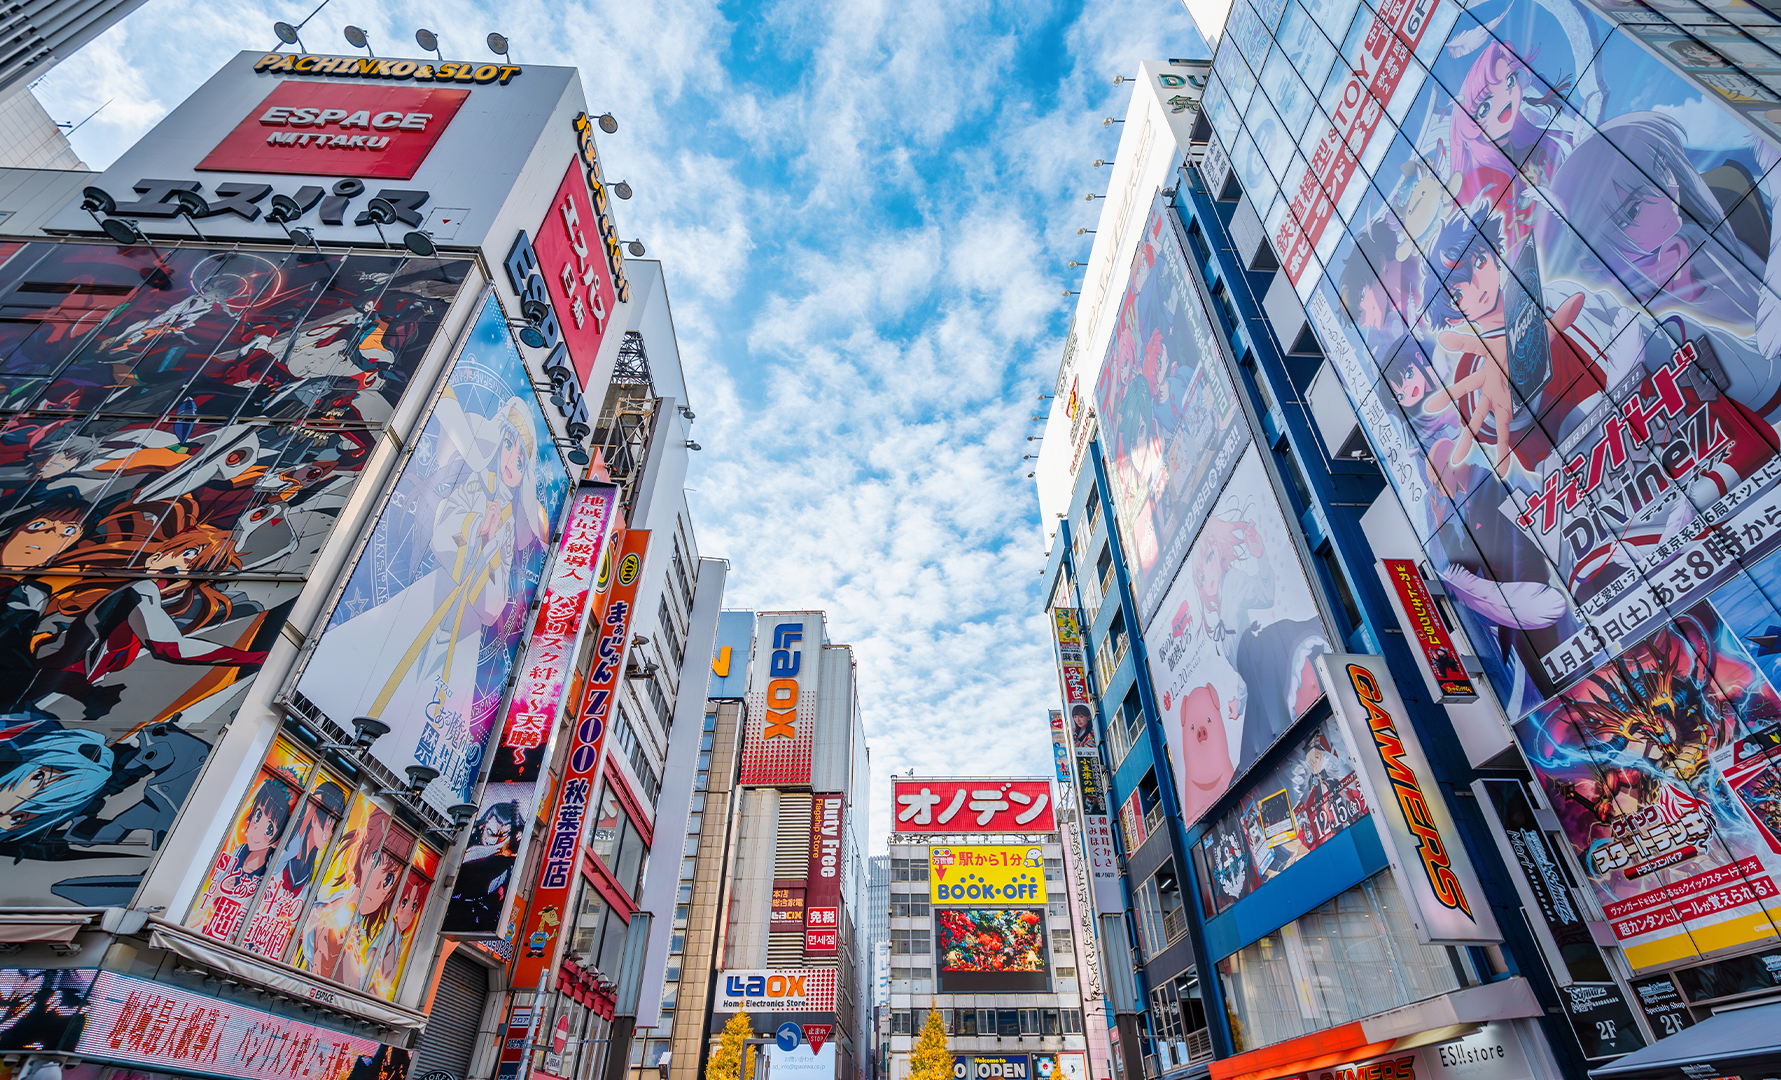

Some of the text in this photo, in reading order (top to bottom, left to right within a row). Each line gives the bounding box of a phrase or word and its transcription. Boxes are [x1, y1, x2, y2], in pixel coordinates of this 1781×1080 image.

[1332, 54, 1371, 127] TOY
[258, 105, 433, 132] ESPACE
[266, 130, 390, 151] NITTAKU
[110, 178, 430, 229] エスパス
[560, 194, 605, 334] エスパス
[1517, 341, 1699, 533] ヴァンガード
[1397, 570, 1442, 645] カードキングダム
[541, 600, 629, 889] まぁじゃん ZOO 秋葉原店
[897, 783, 1050, 826] オノデン
[1346, 663, 1477, 925] GAMERS
[812, 798, 823, 859] Flagship Store
[1612, 805, 1660, 838] クイック
[820, 799, 842, 878] Duty Free
[1593, 809, 1710, 874] スタートデッキ
[959, 851, 1022, 867] 駅から1分
[772, 898, 804, 907] 総合家電
[773, 889, 789, 898] 本店
[810, 910, 835, 923] 免税
[808, 934, 835, 946] 면세점
[315, 990, 334, 1004] ESPACE
[787, 999, 806, 1007] Store
[1644, 1003, 1669, 1015] Specialty
[808, 1027, 826, 1035] 止まれ
[1595, 1019, 1618, 1040] 2F
[1660, 1012, 1684, 1035] 2F
